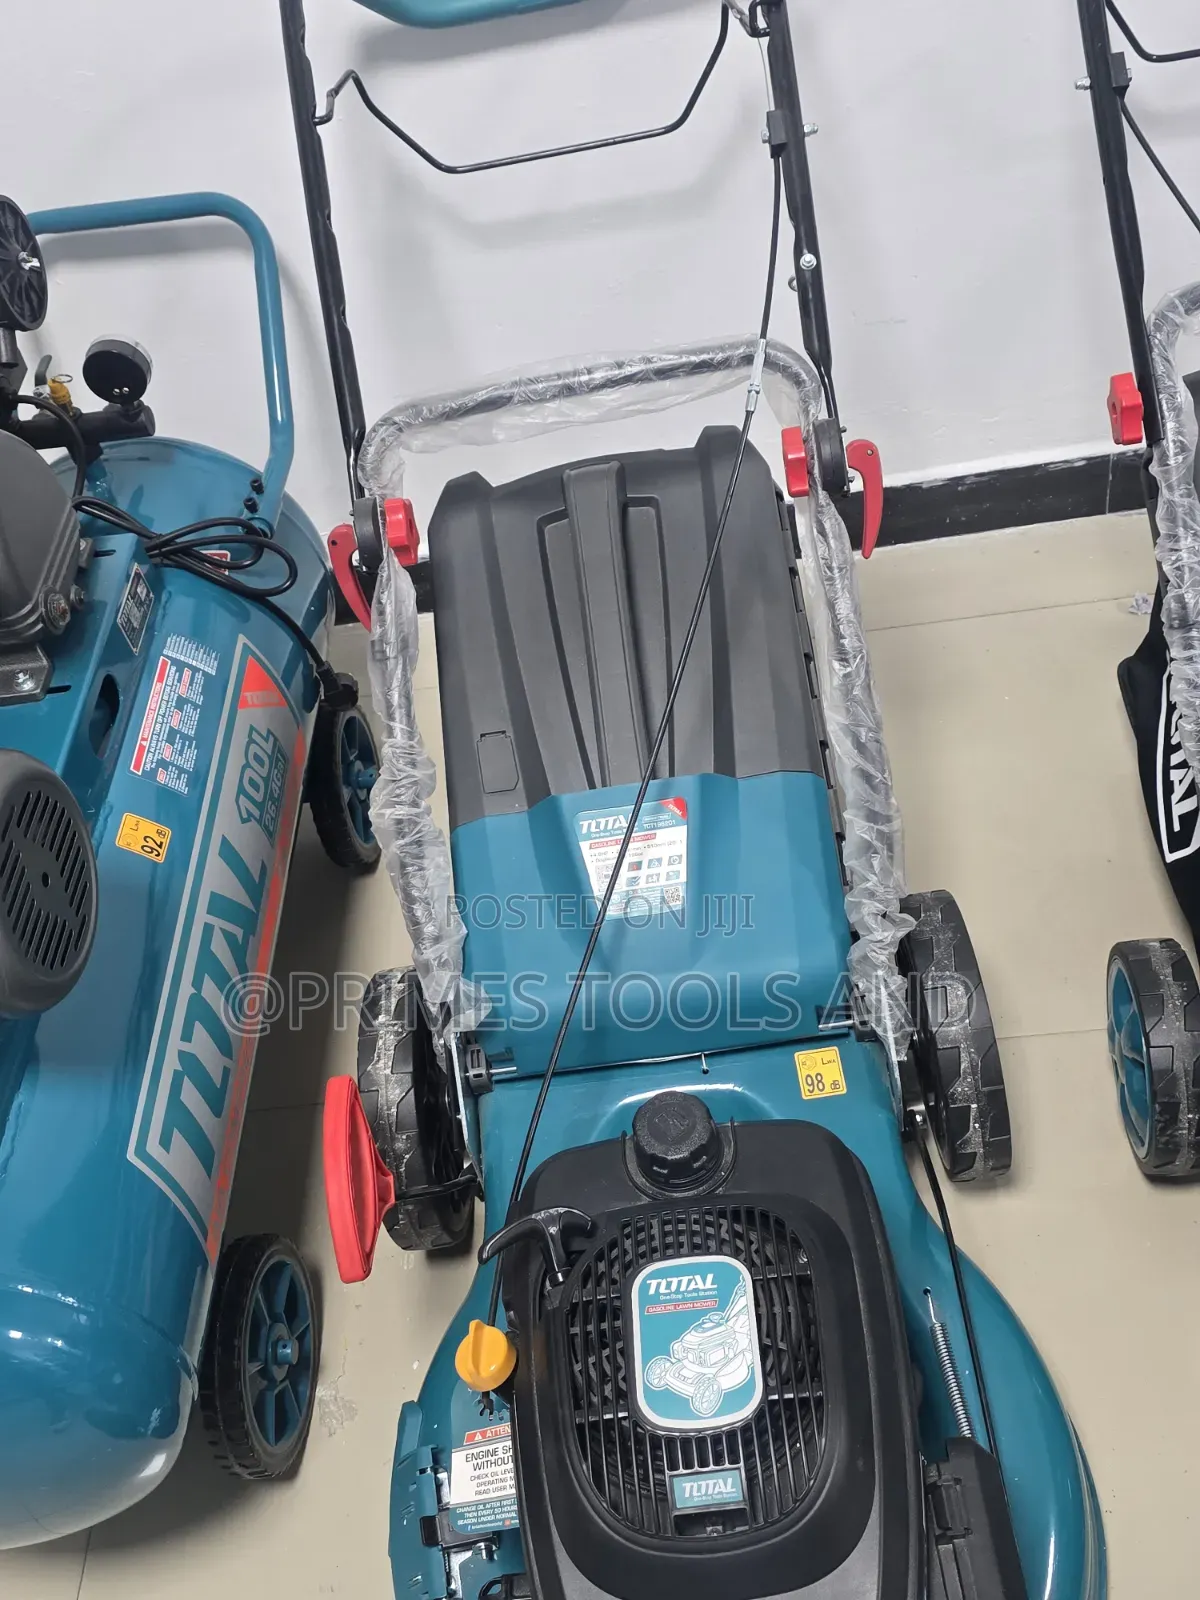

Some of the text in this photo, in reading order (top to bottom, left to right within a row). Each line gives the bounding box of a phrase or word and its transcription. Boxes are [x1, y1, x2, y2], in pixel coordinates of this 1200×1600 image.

[238, 727, 275, 823] 100L
[141, 829, 167, 857] 92 dB
[158, 833, 268, 1182] TOTAL
[805, 1072, 841, 1094] 98 dB
[647, 1273, 718, 1296] TOTAL
[684, 1290, 698, 1298] Tools
[648, 1300, 716, 1313] GASOLINE LAWN MOWER
[465, 1447, 500, 1463] ENGINE
[470, 1472, 489, 1482] CHECK
[476, 1476, 508, 1488] OPERATING
[475, 1488, 490, 1497] READ
[492, 1485, 507, 1493] USER
[682, 1477, 737, 1498] TOTAL
[456, 1505, 476, 1513] CHANGE
[501, 1498, 515, 1506] FIRST
[457, 1518, 477, 1526] SEASON
[478, 1515, 495, 1523] UNDER
[464, 1511, 477, 1519] THEN
